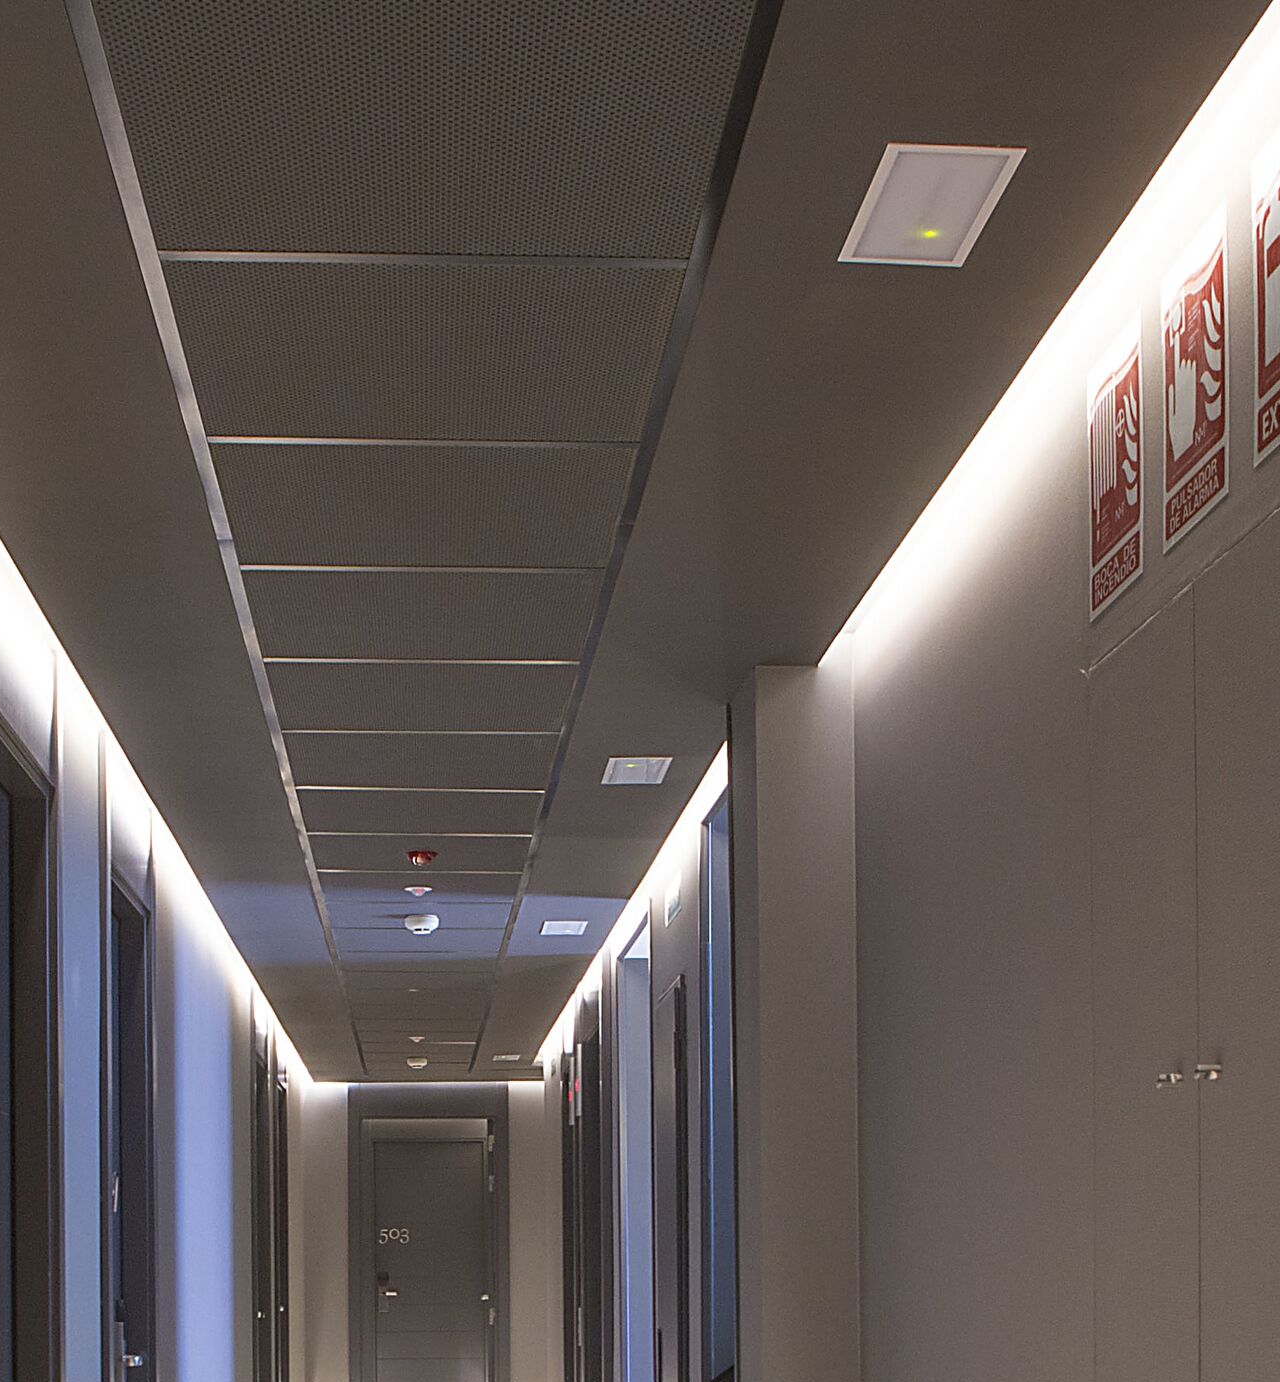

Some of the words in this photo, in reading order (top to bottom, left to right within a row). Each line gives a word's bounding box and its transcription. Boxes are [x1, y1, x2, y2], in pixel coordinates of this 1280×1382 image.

[1169, 511, 1181, 534] DE
[1182, 475, 1220, 522] ALARMA
[1171, 457, 1218, 515] PULSADOR
[1094, 557, 1119, 590] BOCA
[1123, 537, 1136, 560] DE
[1094, 555, 1136, 606] INCENDIO
[379, 1228, 409, 1244] 503
